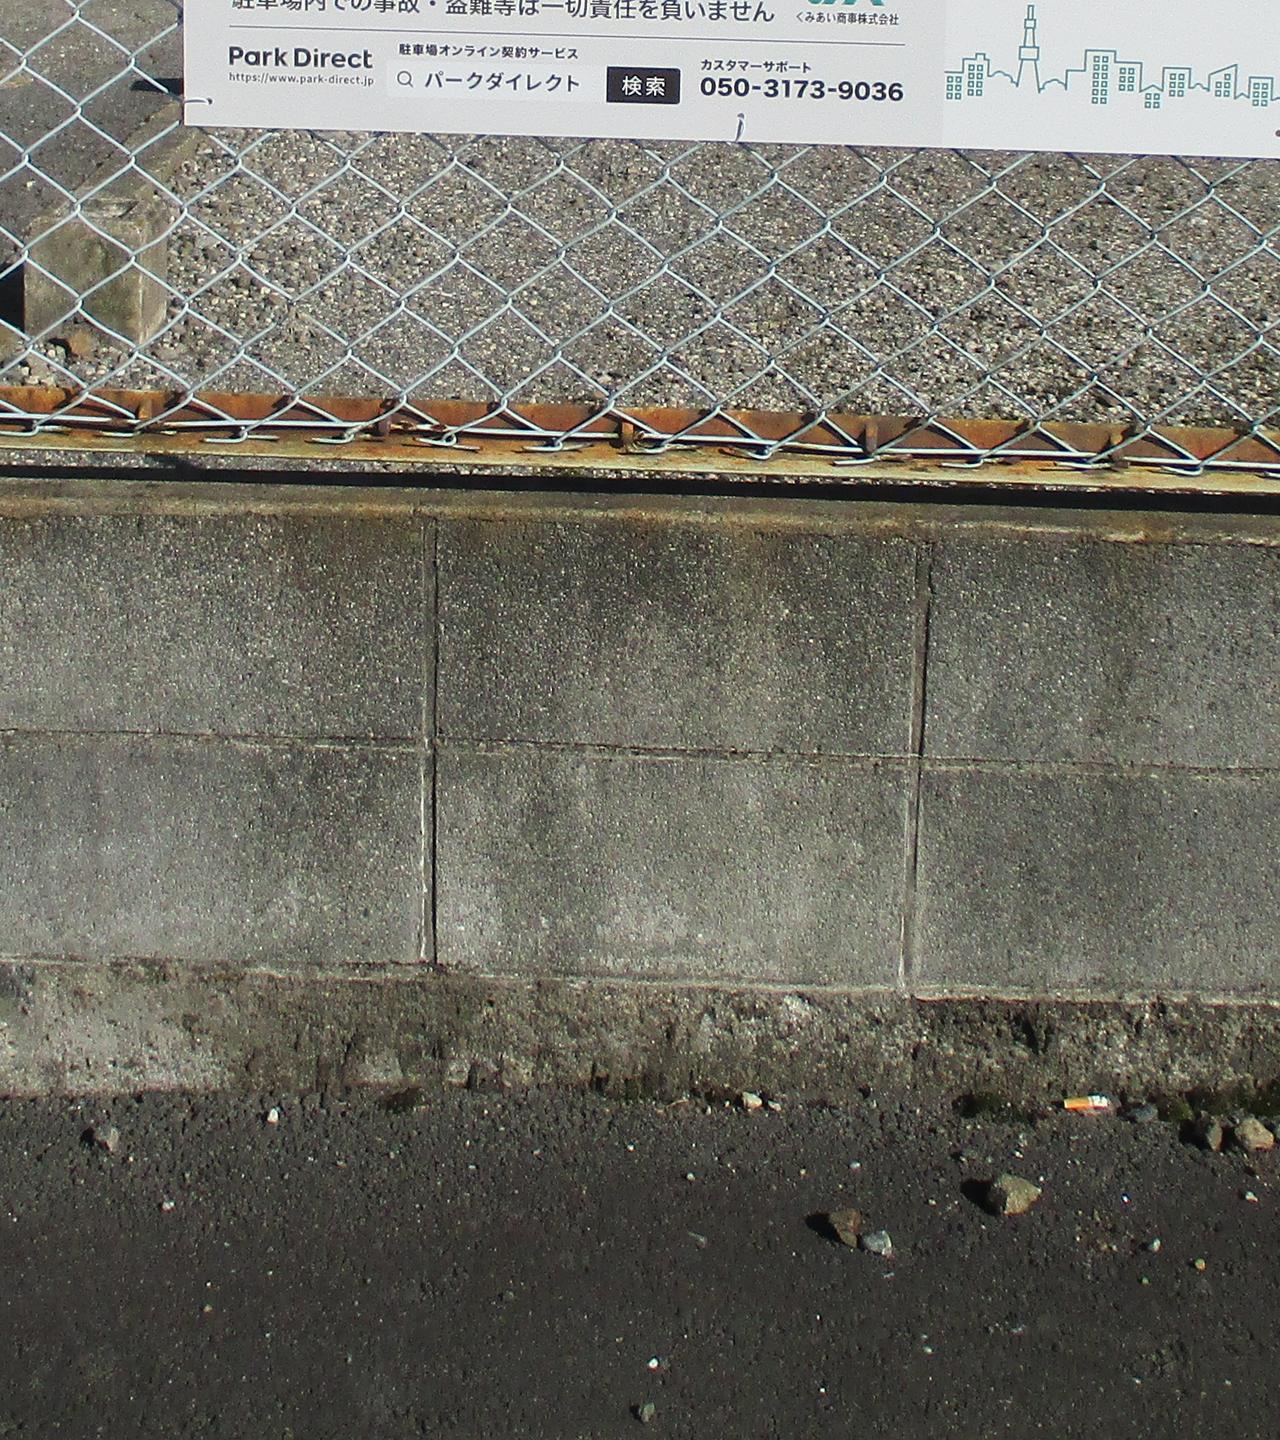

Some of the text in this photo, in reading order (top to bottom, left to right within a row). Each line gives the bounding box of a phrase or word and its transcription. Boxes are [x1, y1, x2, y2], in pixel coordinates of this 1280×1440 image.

[794, 11, 900, 27] くみあい商事株式会社
[228, 45, 374, 70] Park Direct
[398, 42, 580, 61] 駐車場オンライン契約サービス
[700, 59, 812, 74] カスタマーサポート
[228, 71, 375, 87] https://www.park-direct.jp
[424, 69, 581, 93] パークダイレクト
[621, 75, 666, 98] 検索
[699, 76, 905, 102] 050-3173-9036
